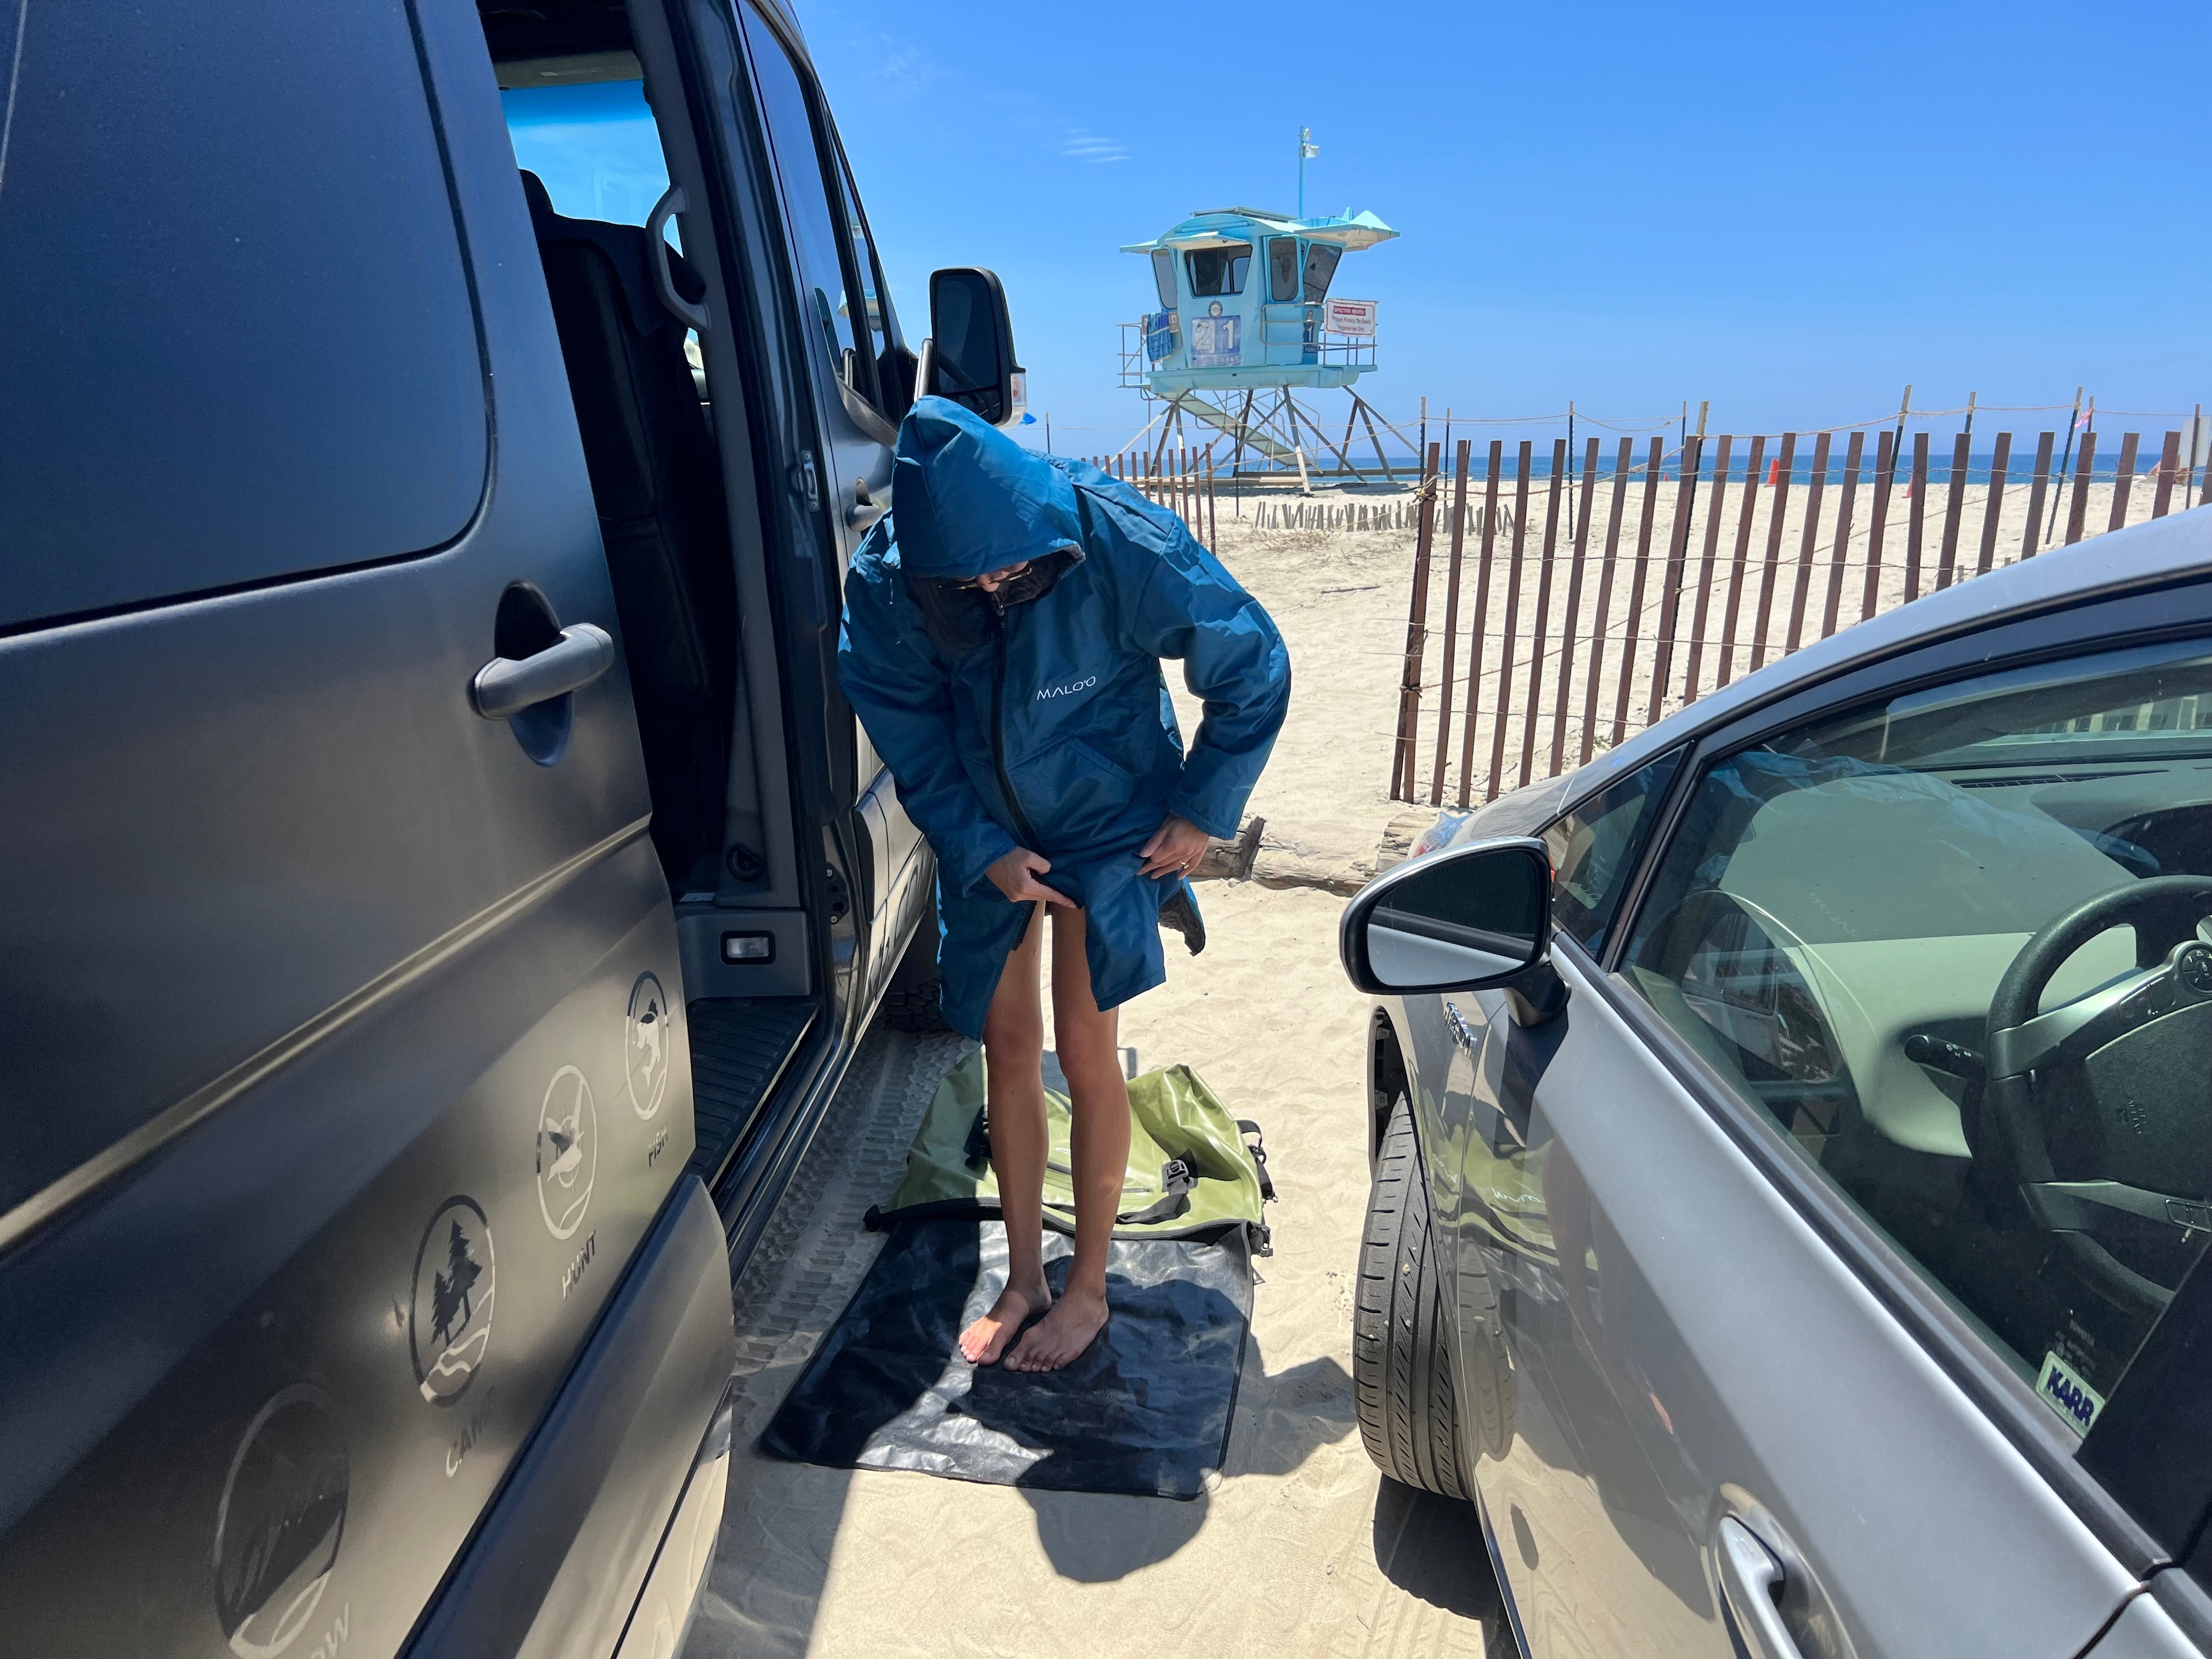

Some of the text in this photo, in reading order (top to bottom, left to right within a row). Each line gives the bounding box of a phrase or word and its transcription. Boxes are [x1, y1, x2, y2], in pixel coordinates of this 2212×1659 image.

[1217, 356, 1240, 364] PARKS
[648, 1122, 668, 1167] FISH
[562, 1229, 596, 1299] HUNT
[2047, 1367, 2094, 1426] KARR
